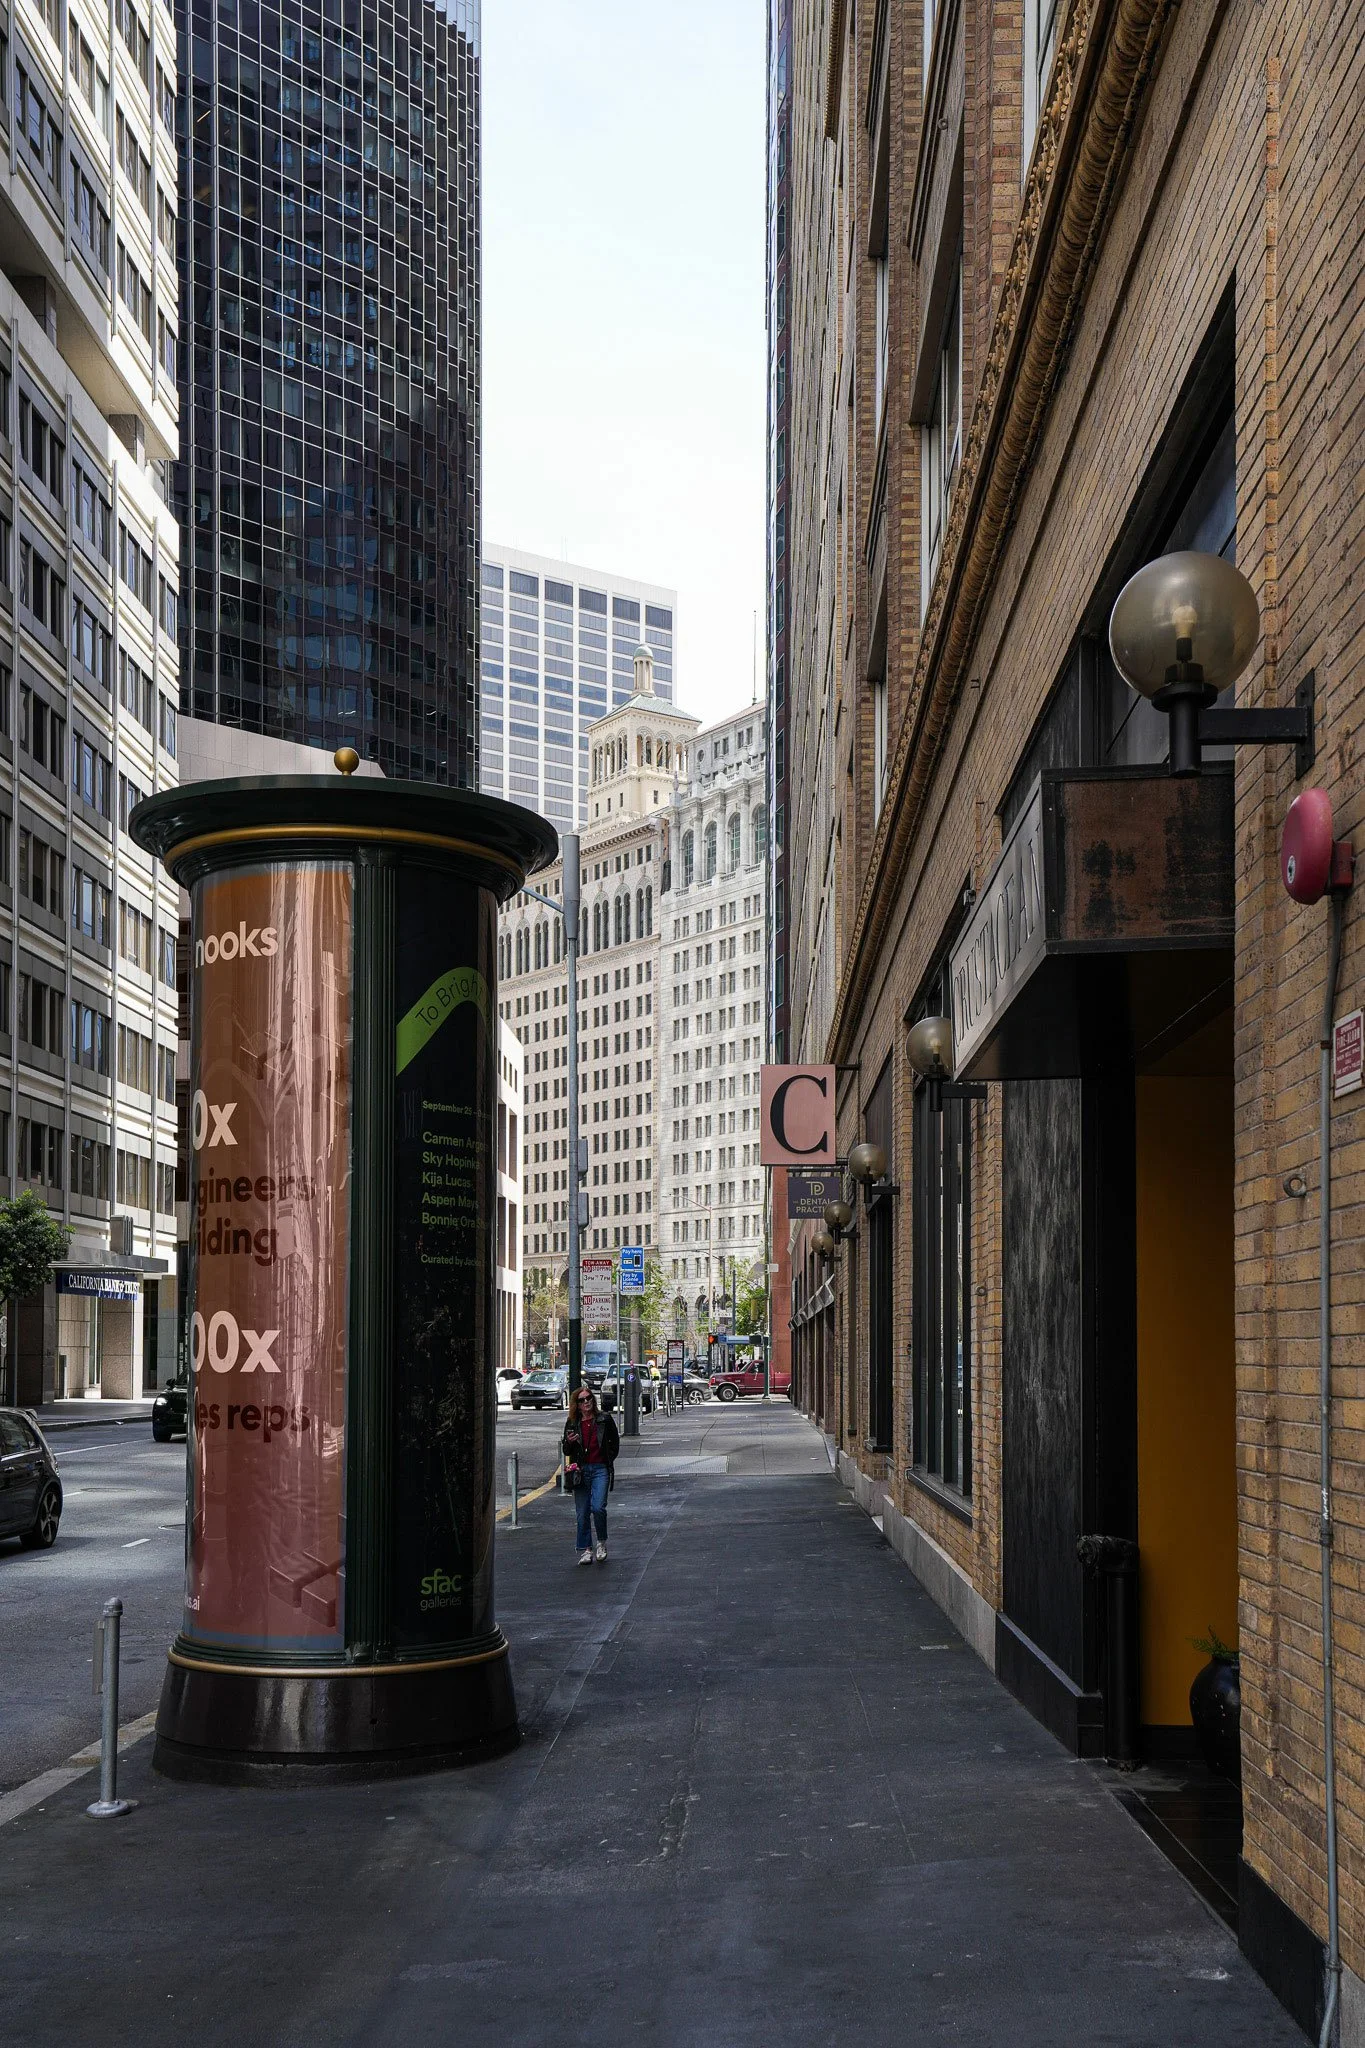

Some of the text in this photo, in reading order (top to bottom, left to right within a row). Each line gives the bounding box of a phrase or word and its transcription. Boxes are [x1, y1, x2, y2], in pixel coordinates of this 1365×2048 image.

[195, 920, 279, 969] nooks
[415, 1005, 439, 1026] To
[422, 1100, 463, 1114] September
[770, 1074, 828, 1155] C
[422, 1131, 464, 1147] Carmen
[422, 1151, 443, 1167] Sky
[422, 1172, 472, 1189] Kija Lucas
[422, 1192, 480, 1213] Aspen Mays
[421, 1212, 458, 1227] Bonnie
[421, 1254, 454, 1266] Curated
[454, 1256, 463, 1268] by
[68, 1274, 104, 1291] CALIFORNIA
[104, 1278, 119, 1293] BANK
[124, 1281, 140, 1294] TRUST
[583, 1296, 592, 1305] NO
[190, 1310, 281, 1373] 00x
[227, 1404, 310, 1443] reps
[420, 1567, 463, 1595] sfac
[420, 1595, 463, 1612] galleries
